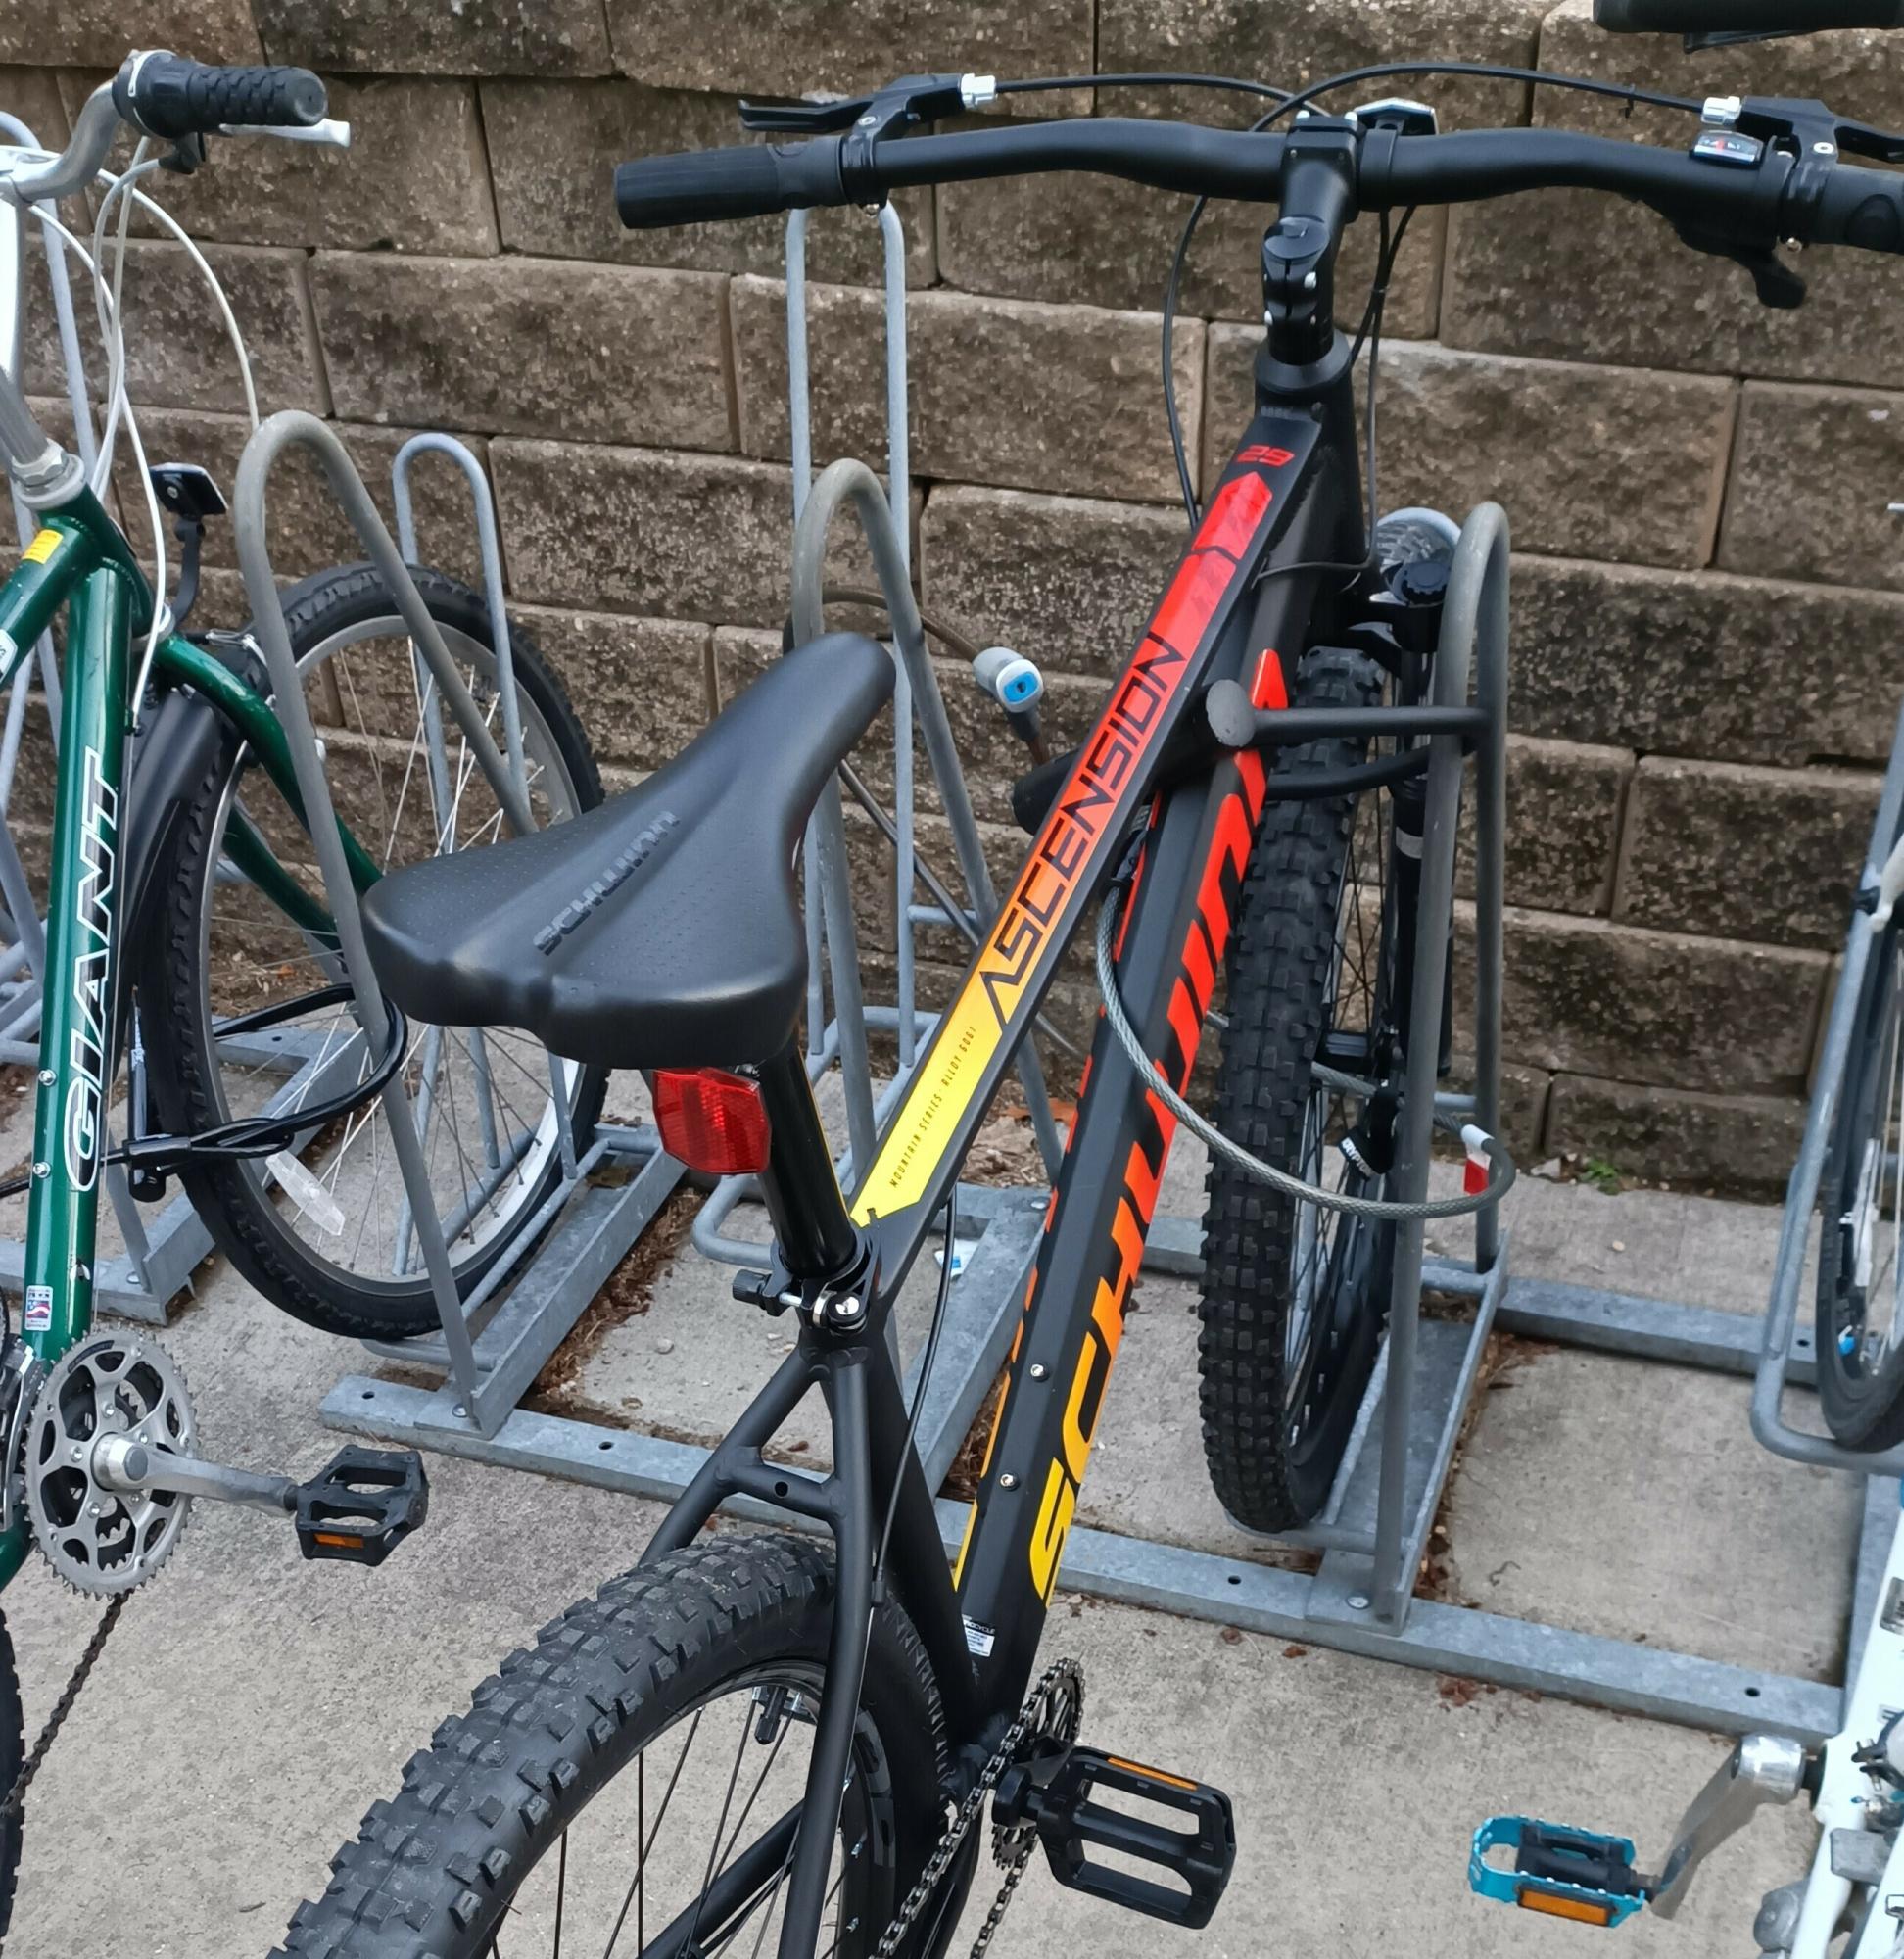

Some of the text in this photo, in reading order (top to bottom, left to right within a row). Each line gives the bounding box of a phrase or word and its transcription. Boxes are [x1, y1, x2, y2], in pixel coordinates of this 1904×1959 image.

[1237, 444, 1296, 467] 29
[532, 810, 682, 957] SCHWINN
[979, 632, 1187, 1027] ASCENSION
[64, 745, 119, 1192] GIANT
[889, 1026, 977, 1189] MOUNTAIN SERIES ALLOY 6061
